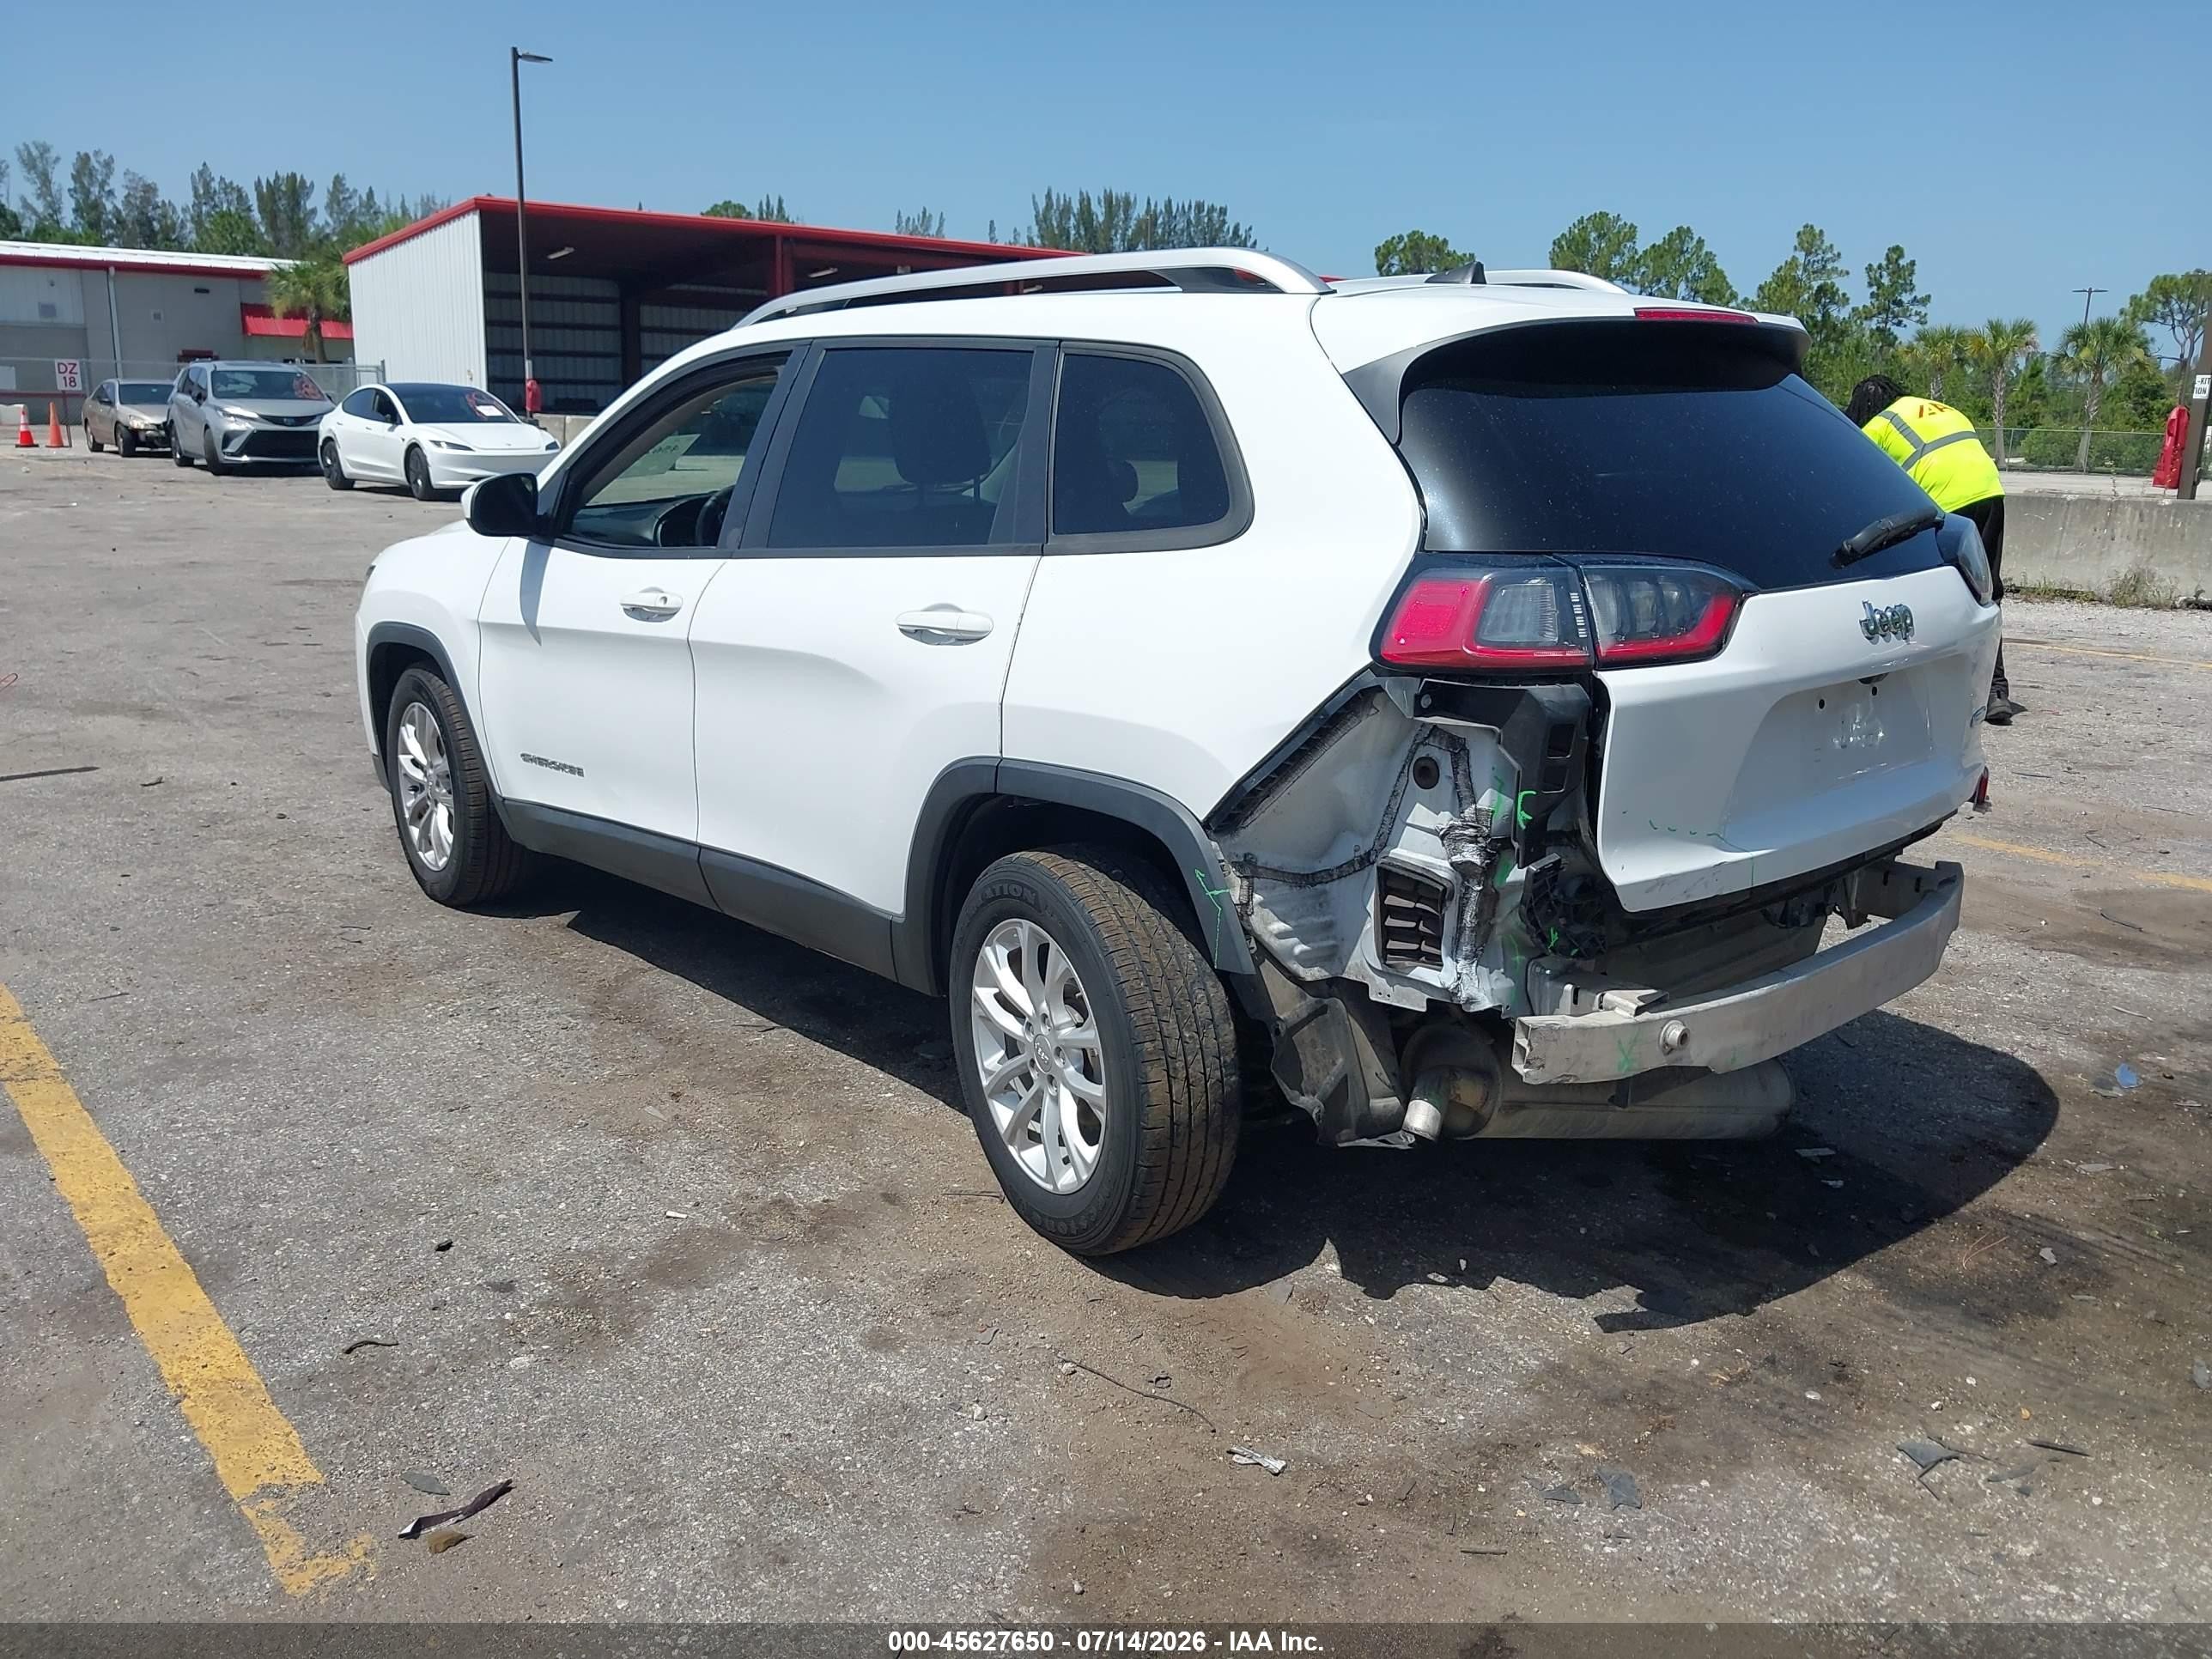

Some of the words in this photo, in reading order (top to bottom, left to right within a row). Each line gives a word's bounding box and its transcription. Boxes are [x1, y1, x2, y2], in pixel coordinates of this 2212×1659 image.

[58, 362, 78, 374] DZ
[63, 376, 77, 388] 18
[1858, 599, 1915, 642] Jeep
[520, 752, 585, 778] CHEROKEE
